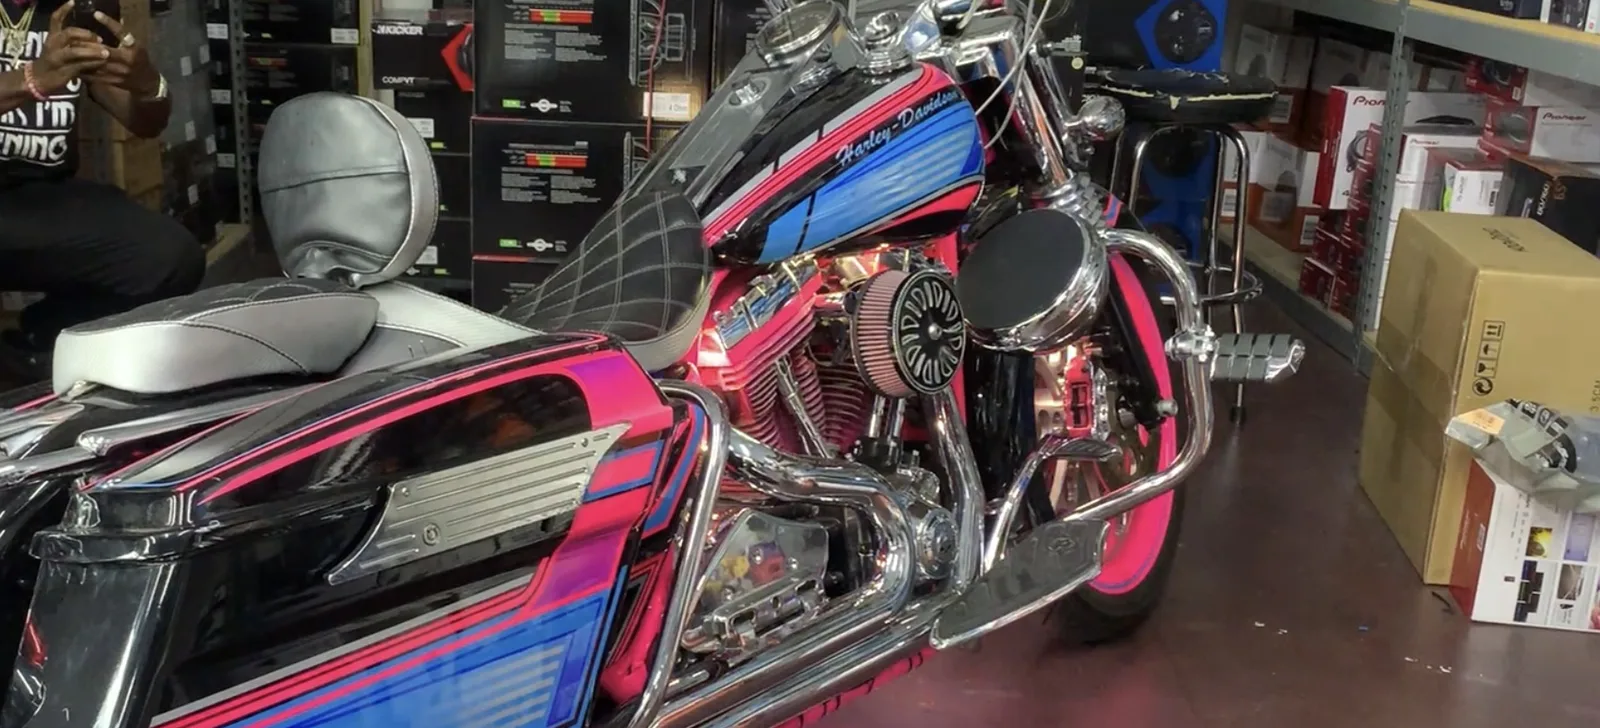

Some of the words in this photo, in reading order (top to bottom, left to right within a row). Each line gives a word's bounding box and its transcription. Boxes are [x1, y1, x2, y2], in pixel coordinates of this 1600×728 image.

[384, 25, 424, 36] KICKER
[1542, 111, 1587, 121] Pioneer
[835, 88, 960, 167] Harley-Davidson
